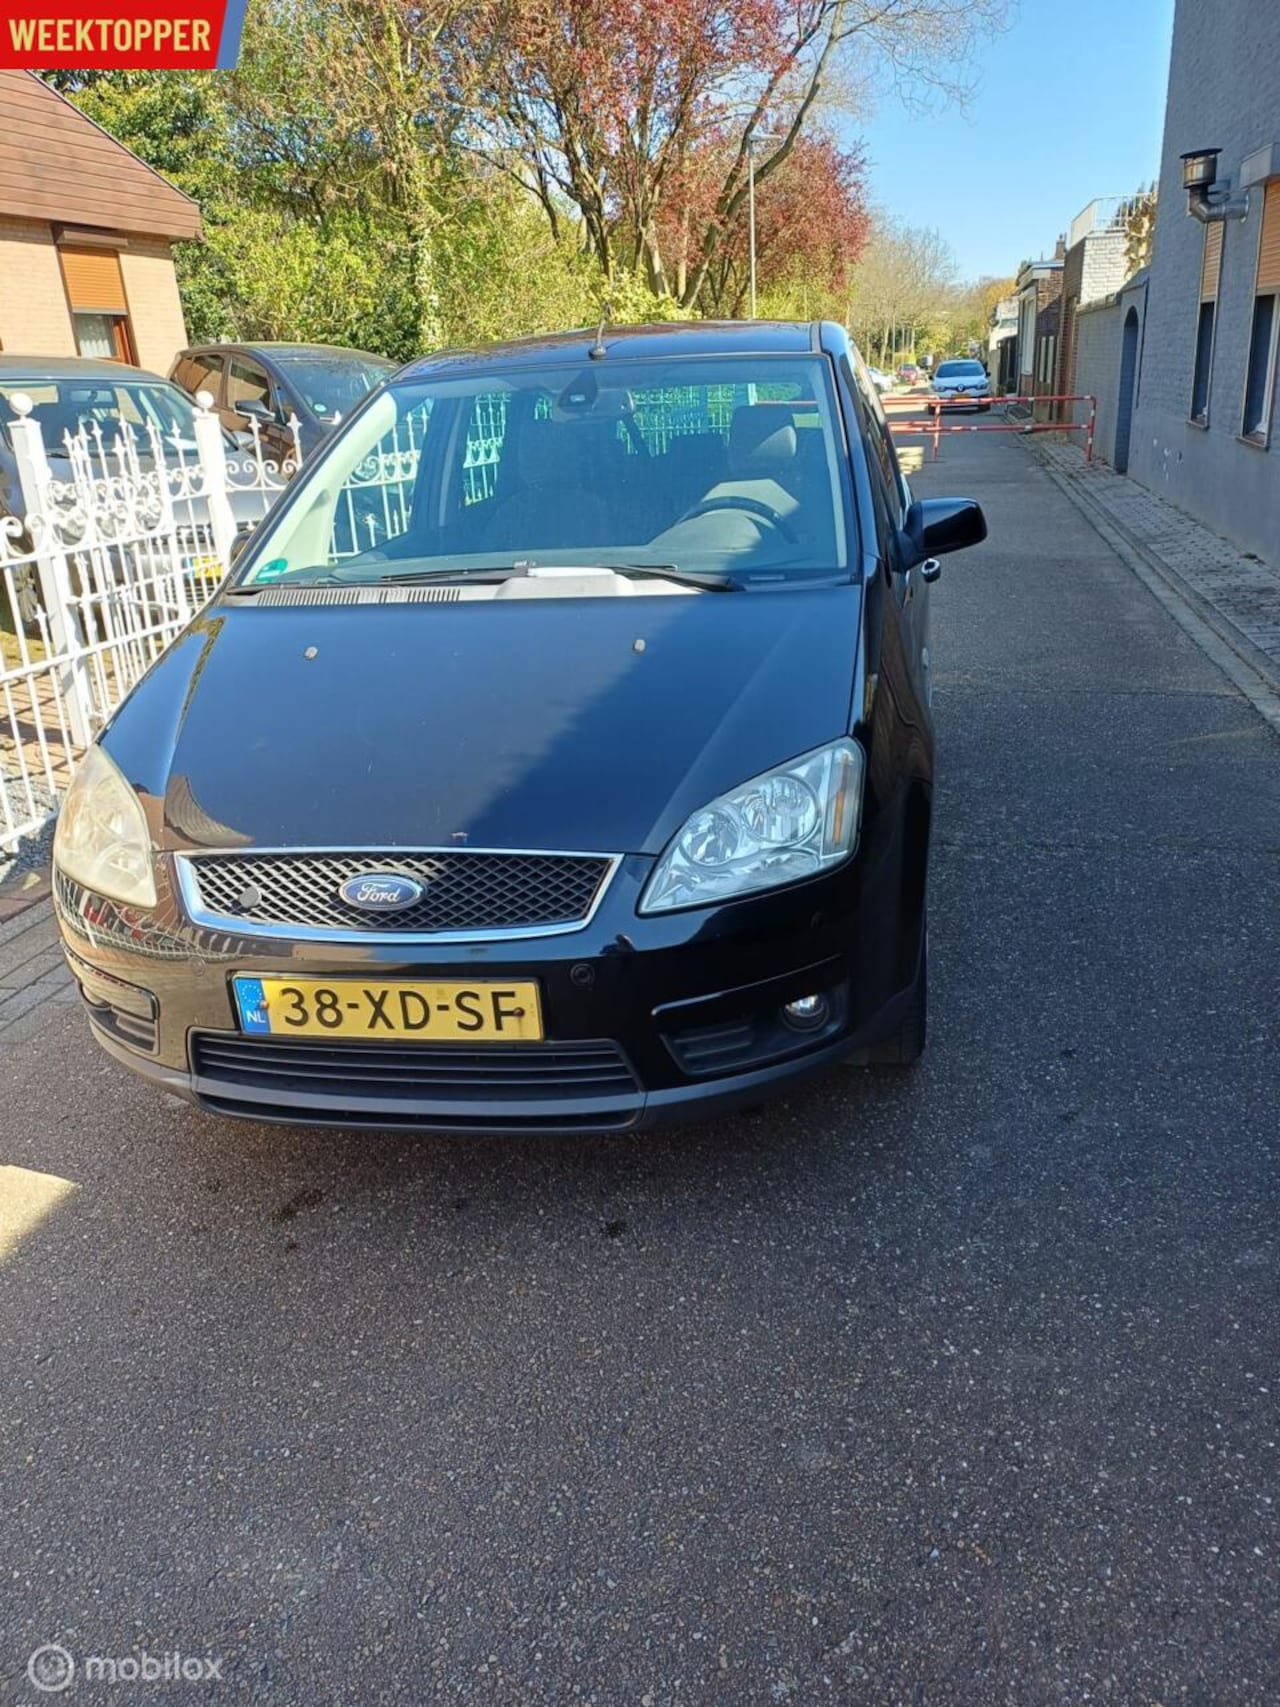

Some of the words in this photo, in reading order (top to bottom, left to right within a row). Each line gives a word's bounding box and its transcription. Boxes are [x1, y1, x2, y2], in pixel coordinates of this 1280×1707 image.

[357, 882, 400, 902] Ford
[245, 1010, 266, 1024] NL
[280, 987, 524, 1032] 38-XD-SF
